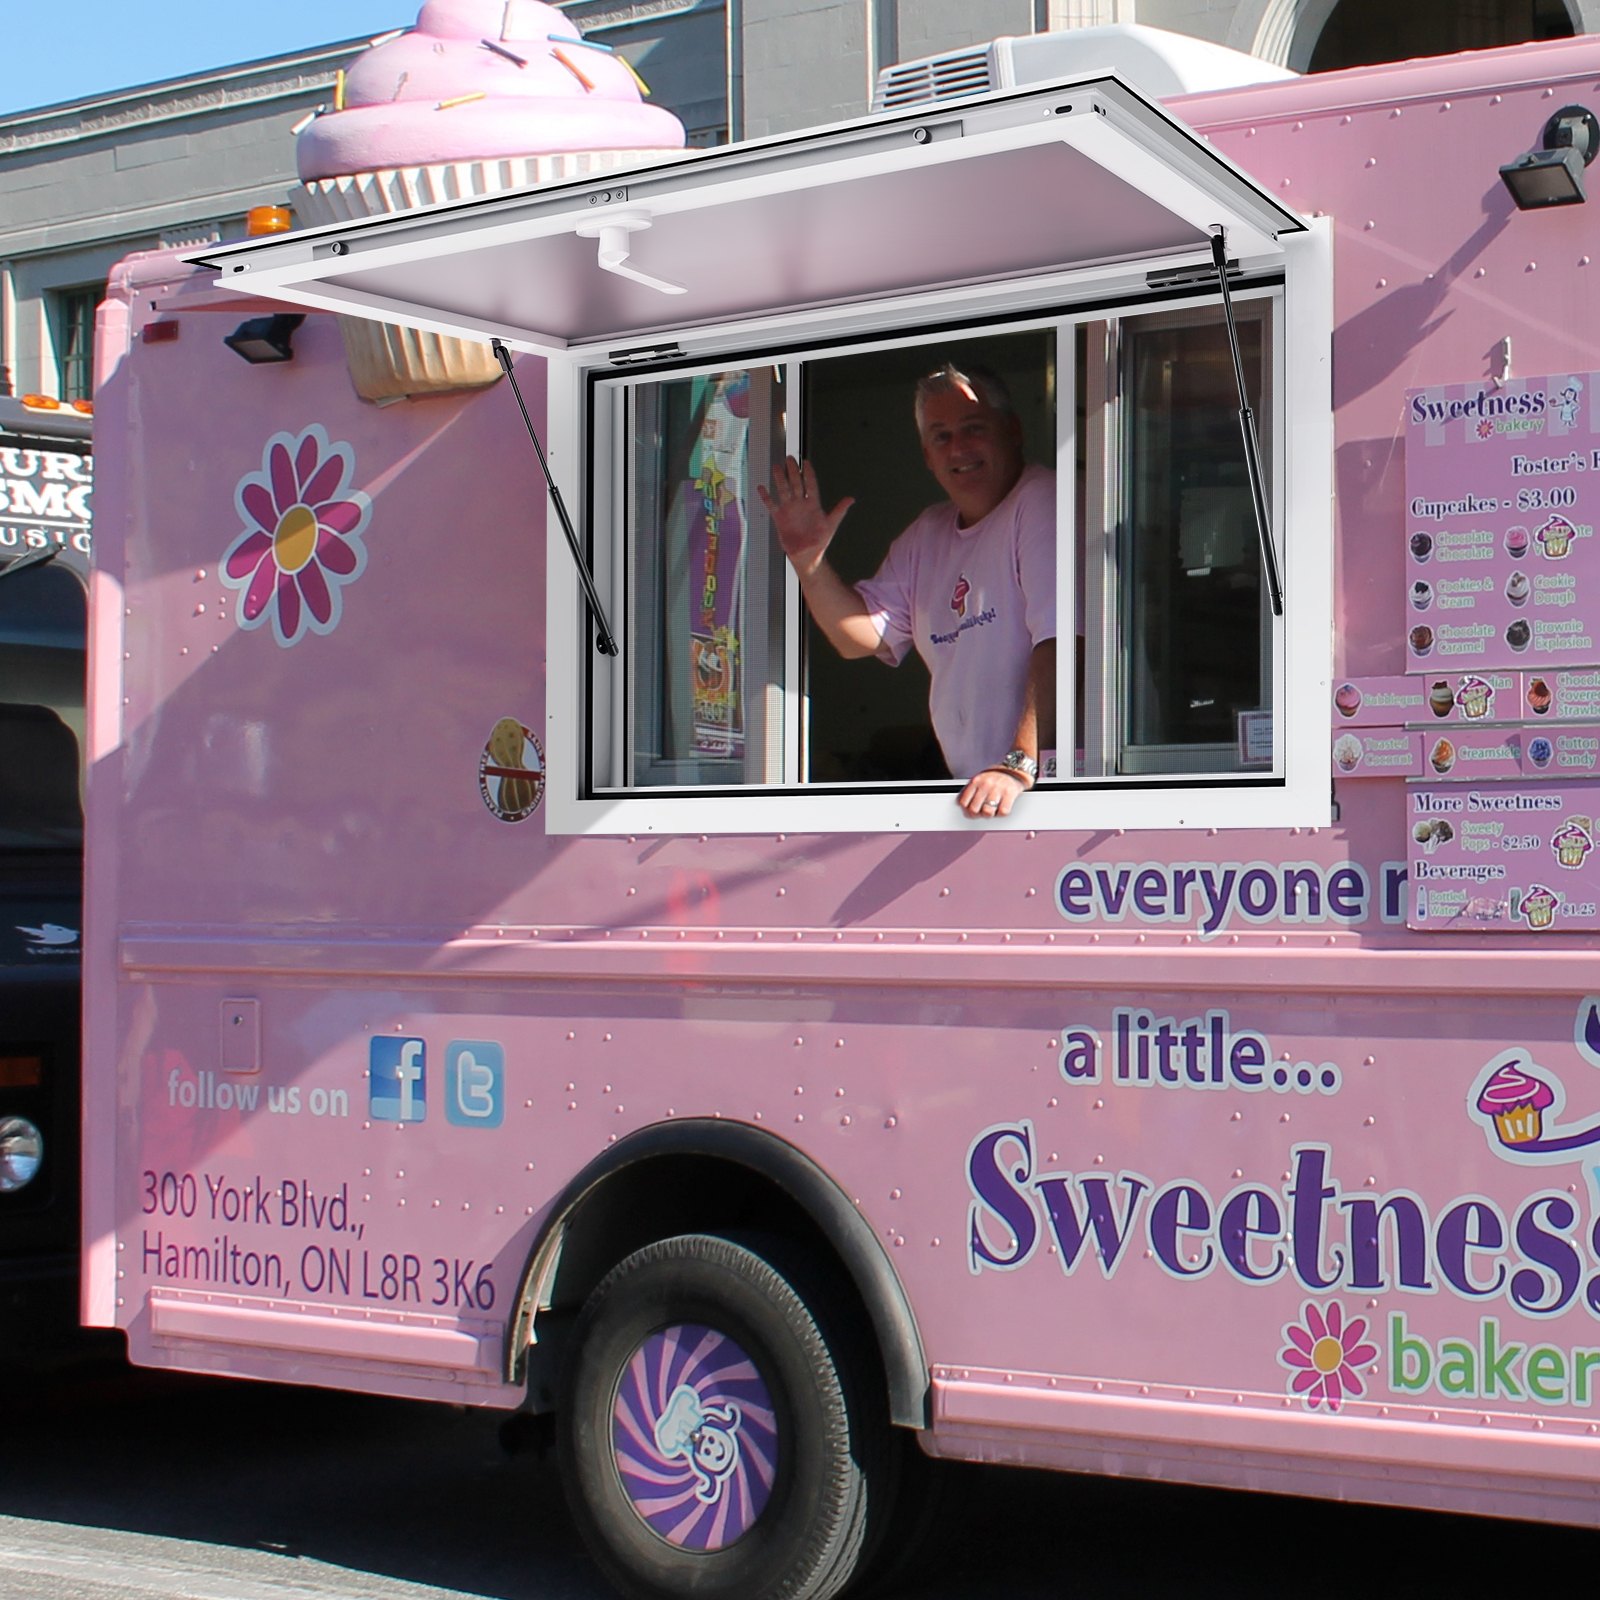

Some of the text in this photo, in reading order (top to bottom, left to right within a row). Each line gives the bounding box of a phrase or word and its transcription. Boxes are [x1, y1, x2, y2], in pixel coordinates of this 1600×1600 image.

[1412, 391, 1546, 423] Sweetness
[1496, 418, 1544, 433] bakery
[1512, 452, 1586, 475] Foster's
[1412, 494, 1497, 519] Cupcakes
[1518, 488, 1575, 509] $3.00
[1436, 531, 1493, 544] Chocolate
[1436, 546, 1494, 561] Chocolate
[1437, 578, 1481, 592] Cookies
[1535, 574, 1575, 588] Cookie
[1437, 595, 1474, 608] Cream
[1535, 590, 1575, 607] Dough
[1438, 624, 1495, 638] Chocolate
[1535, 619, 1583, 633] Brownie
[1438, 640, 1485, 654] Caramel
[1535, 635, 1592, 653] Explosion
[1364, 693, 1424, 708] Bubblegum
[1557, 736, 1598, 750] Cotton
[1459, 746, 1520, 760] Creamsicle
[1558, 752, 1596, 768] Candy
[1414, 791, 1561, 812] More Sweetness
[1461, 820, 1503, 836] Sweety
[1461, 838, 1490, 853] Pops
[1502, 835, 1539, 850] $2.50
[1415, 861, 1505, 883] Beverages
[1059, 865, 1363, 935] everyone
[1562, 903, 1596, 916] $1.25
[1064, 1014, 1337, 1088] a little...
[167, 1068, 348, 1117] follow us on
[141, 1170, 366, 1240] 300 York Blvd.,
[970, 1126, 1600, 1312] Sweetnes
[142, 1230, 495, 1311] Hamilton, ON L8R 3K6
